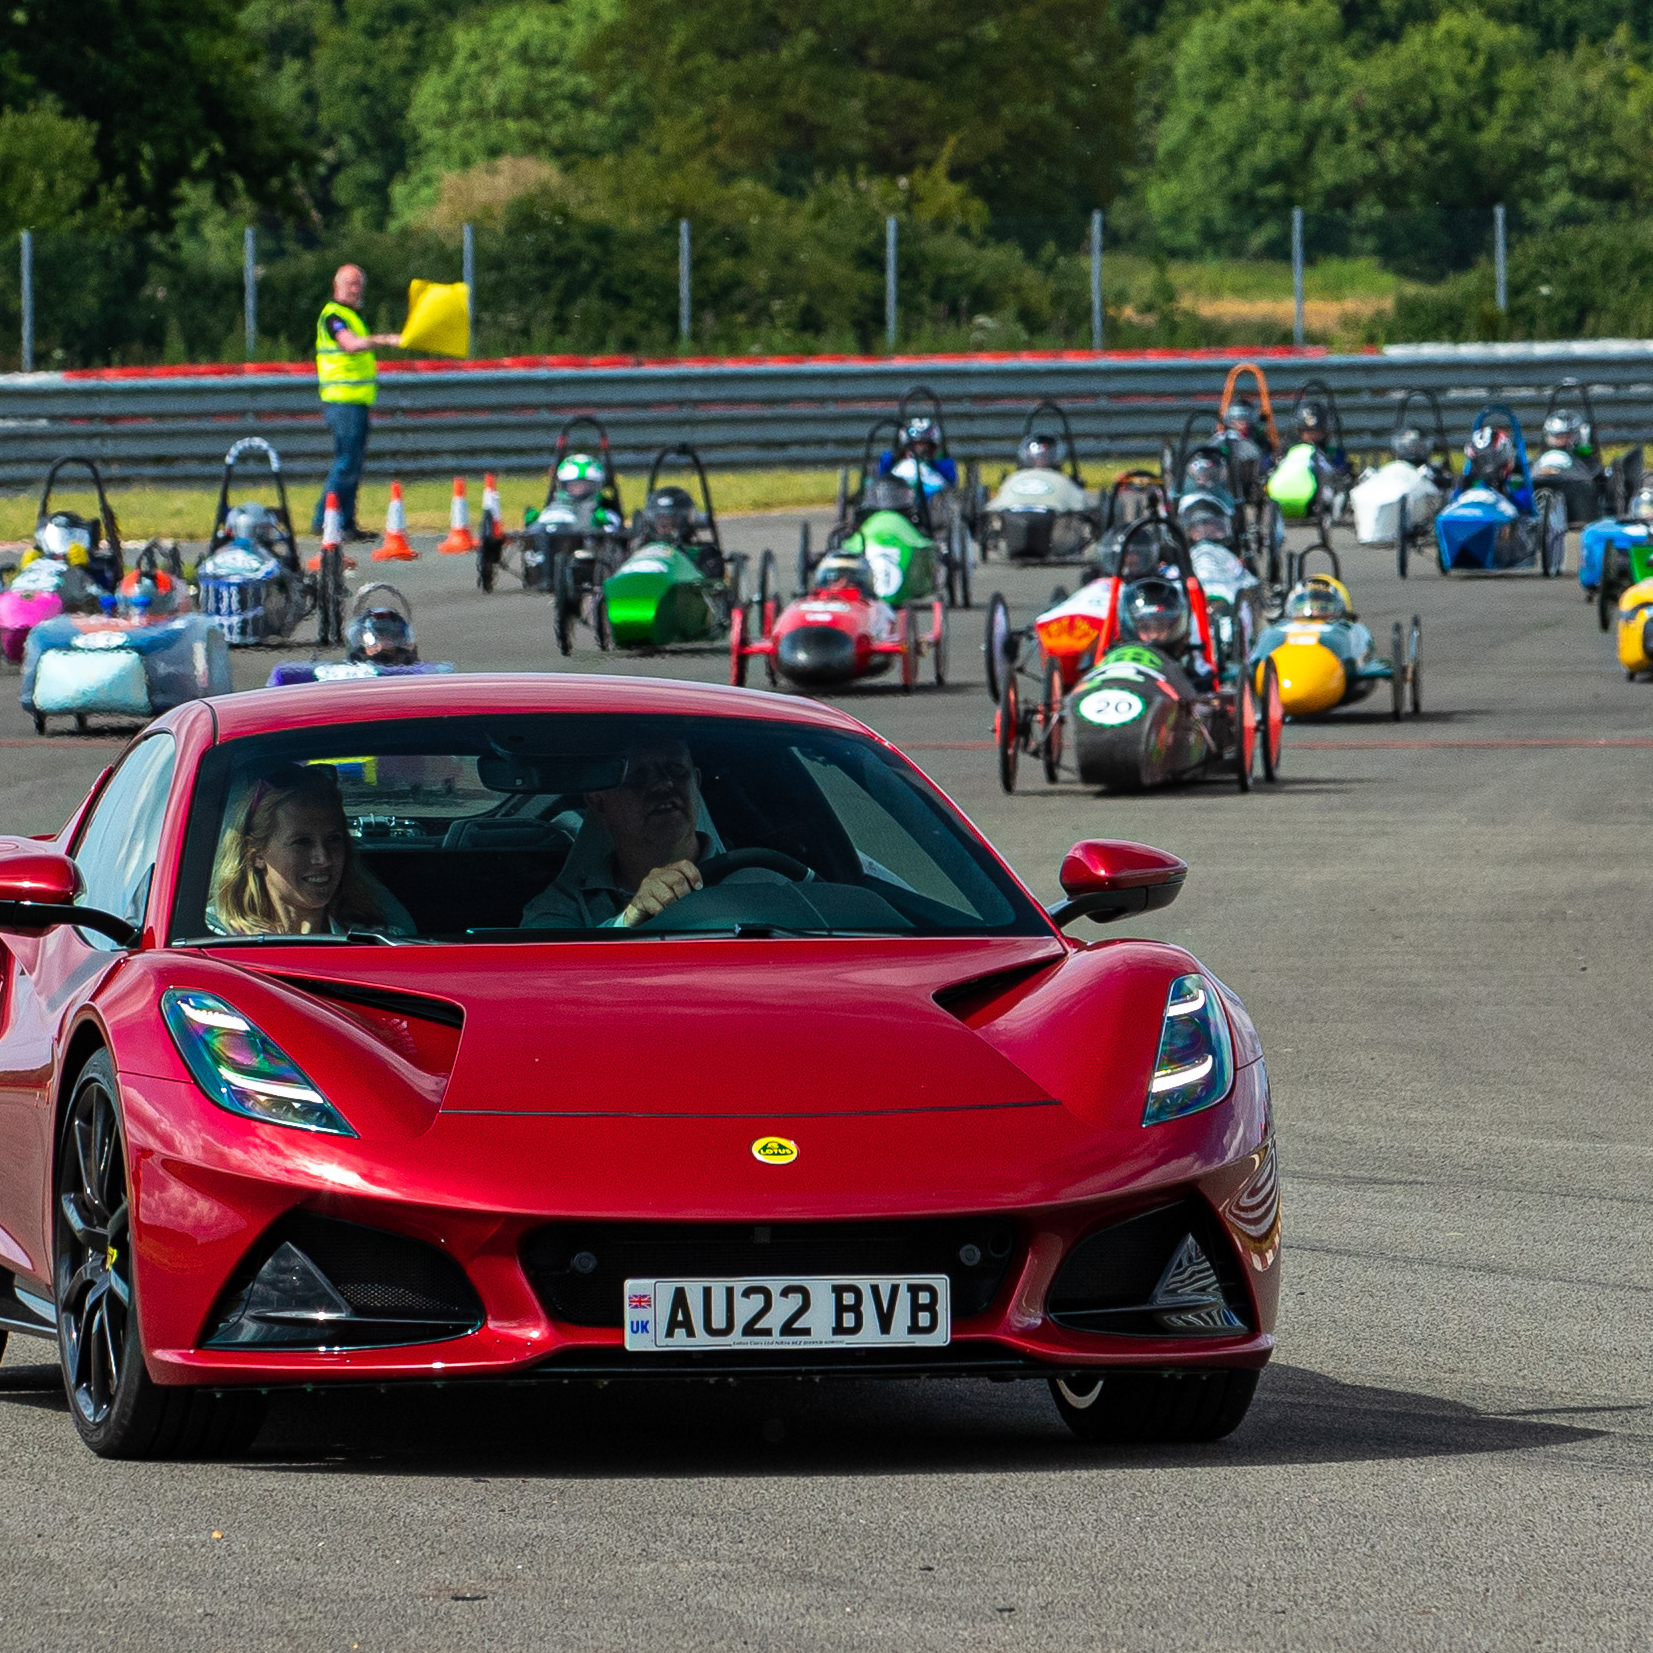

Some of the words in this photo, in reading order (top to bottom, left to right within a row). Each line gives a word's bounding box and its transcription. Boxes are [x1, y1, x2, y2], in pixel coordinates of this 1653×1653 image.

[1096, 700, 1132, 715] 20
[664, 1285, 813, 1338] AU22
[831, 1283, 939, 1336] BVB
[630, 1320, 650, 1335] UK
